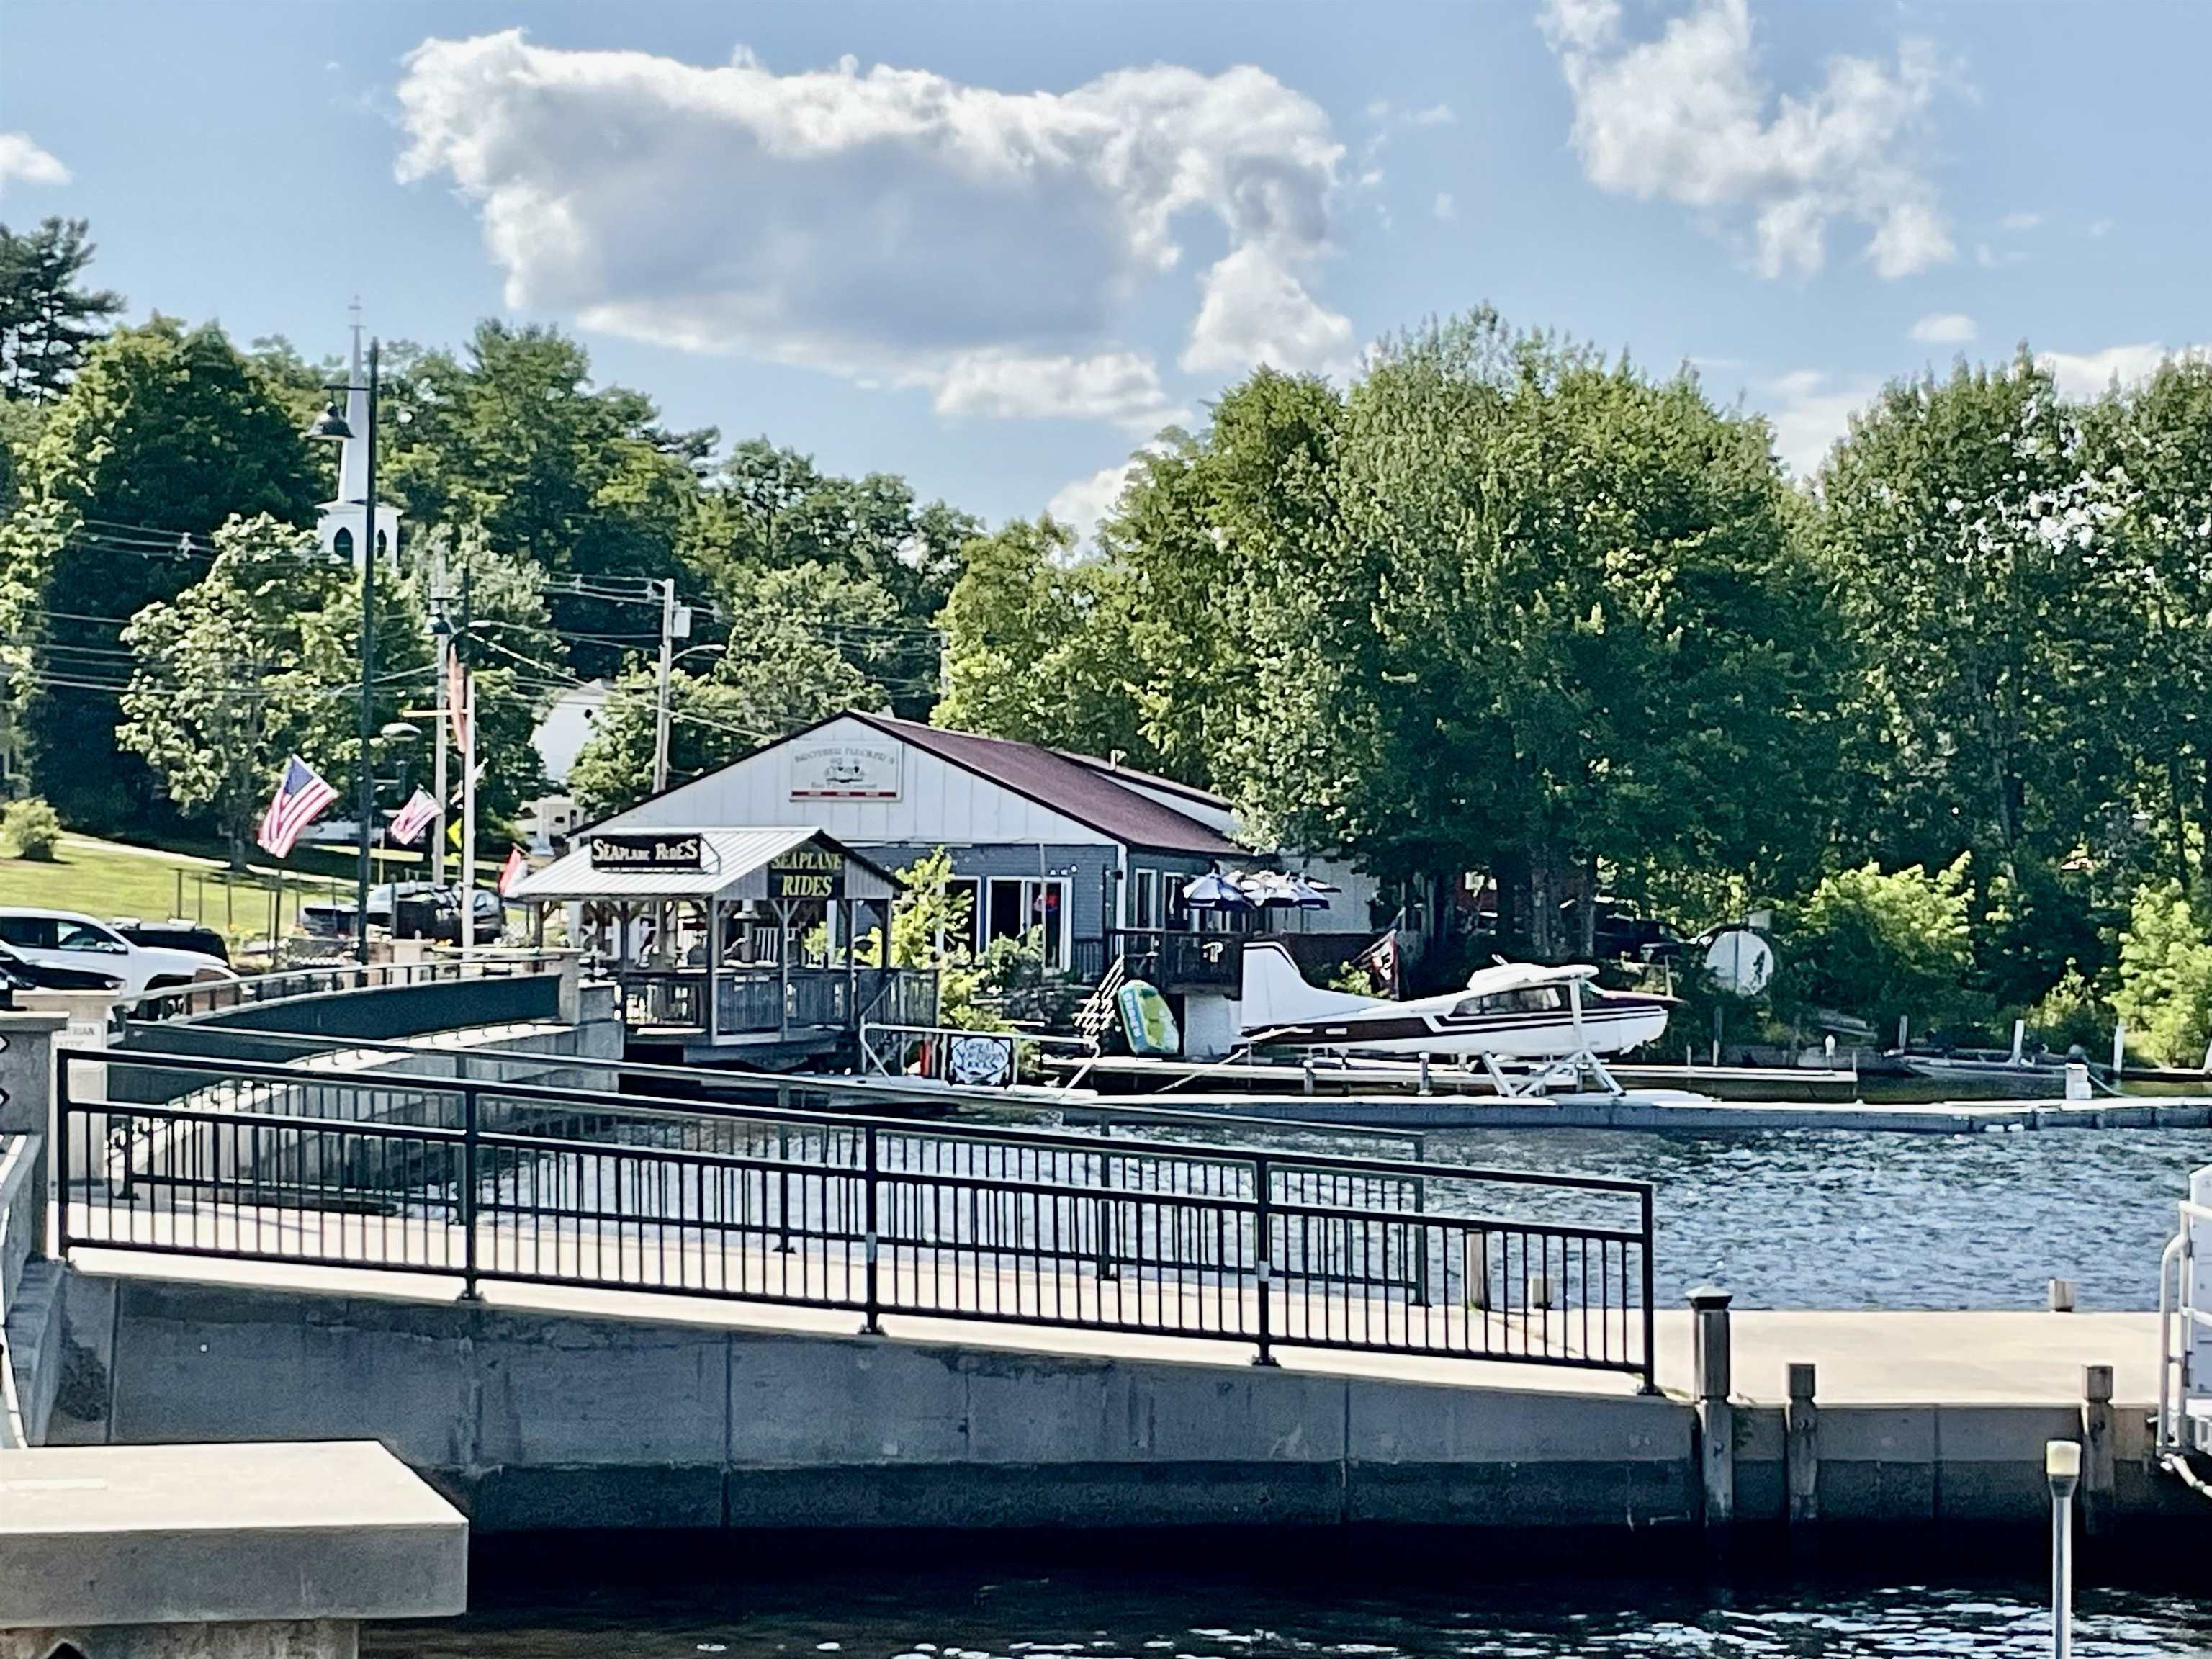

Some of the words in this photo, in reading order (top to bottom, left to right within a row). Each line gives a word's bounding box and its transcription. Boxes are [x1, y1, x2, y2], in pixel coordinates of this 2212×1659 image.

[592, 838, 651, 861] SEAPLANE
[655, 838, 698, 860] RIDES
[771, 852, 842, 871] SEAPLANE
[781, 875, 833, 896] RIDES
